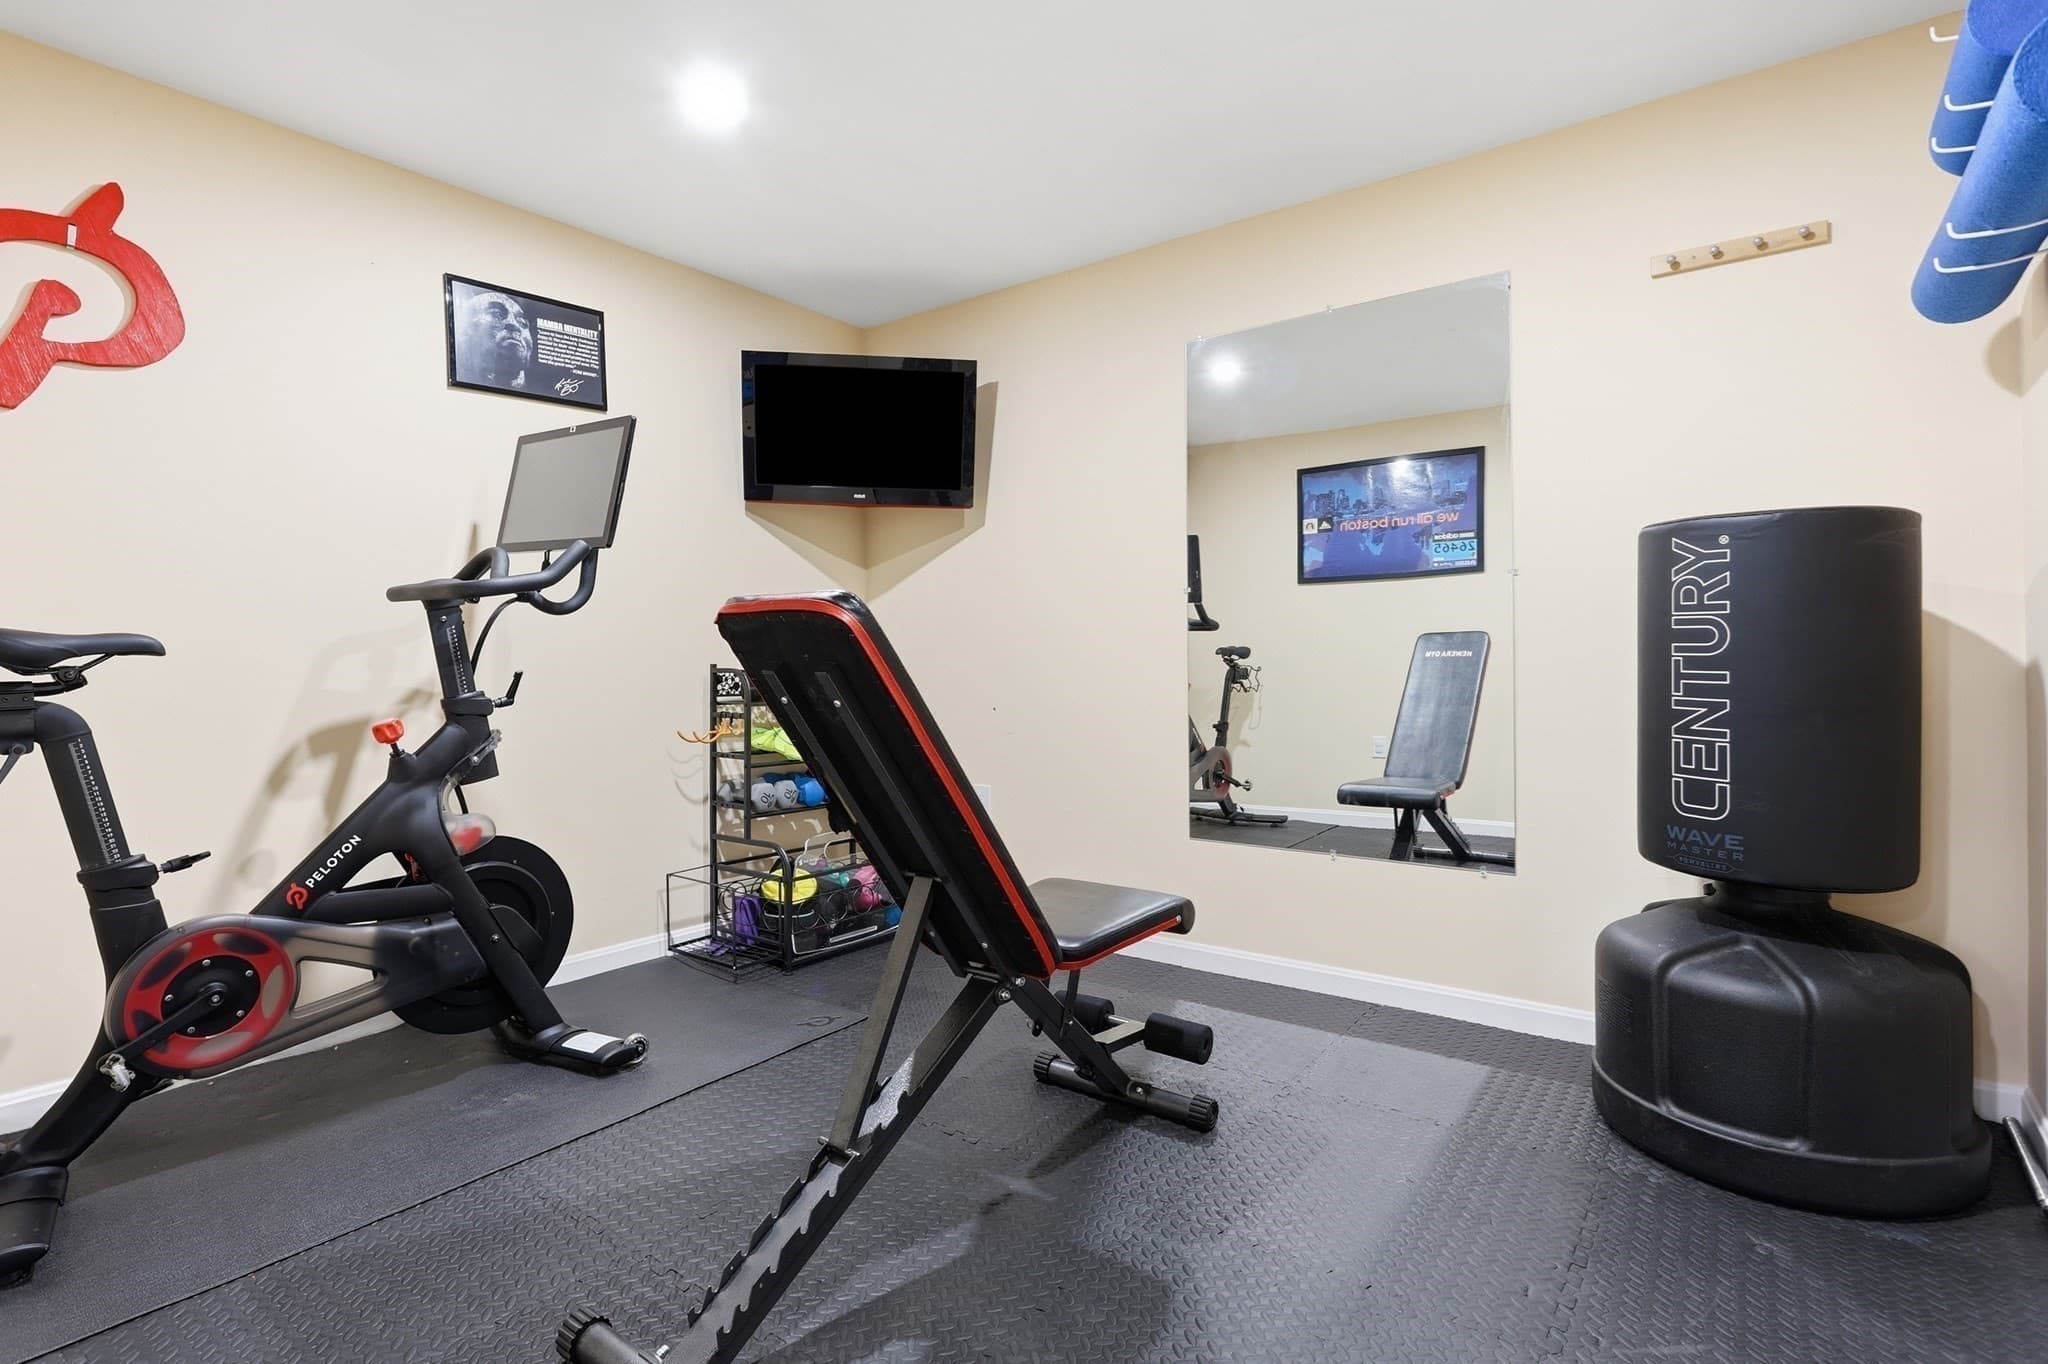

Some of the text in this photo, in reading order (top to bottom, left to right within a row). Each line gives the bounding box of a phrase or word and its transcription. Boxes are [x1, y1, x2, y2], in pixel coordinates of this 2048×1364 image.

[1666, 824, 1744, 851] WAVE
[305, 834, 362, 888] PELOTON
[1667, 841, 1744, 863] MASTER
